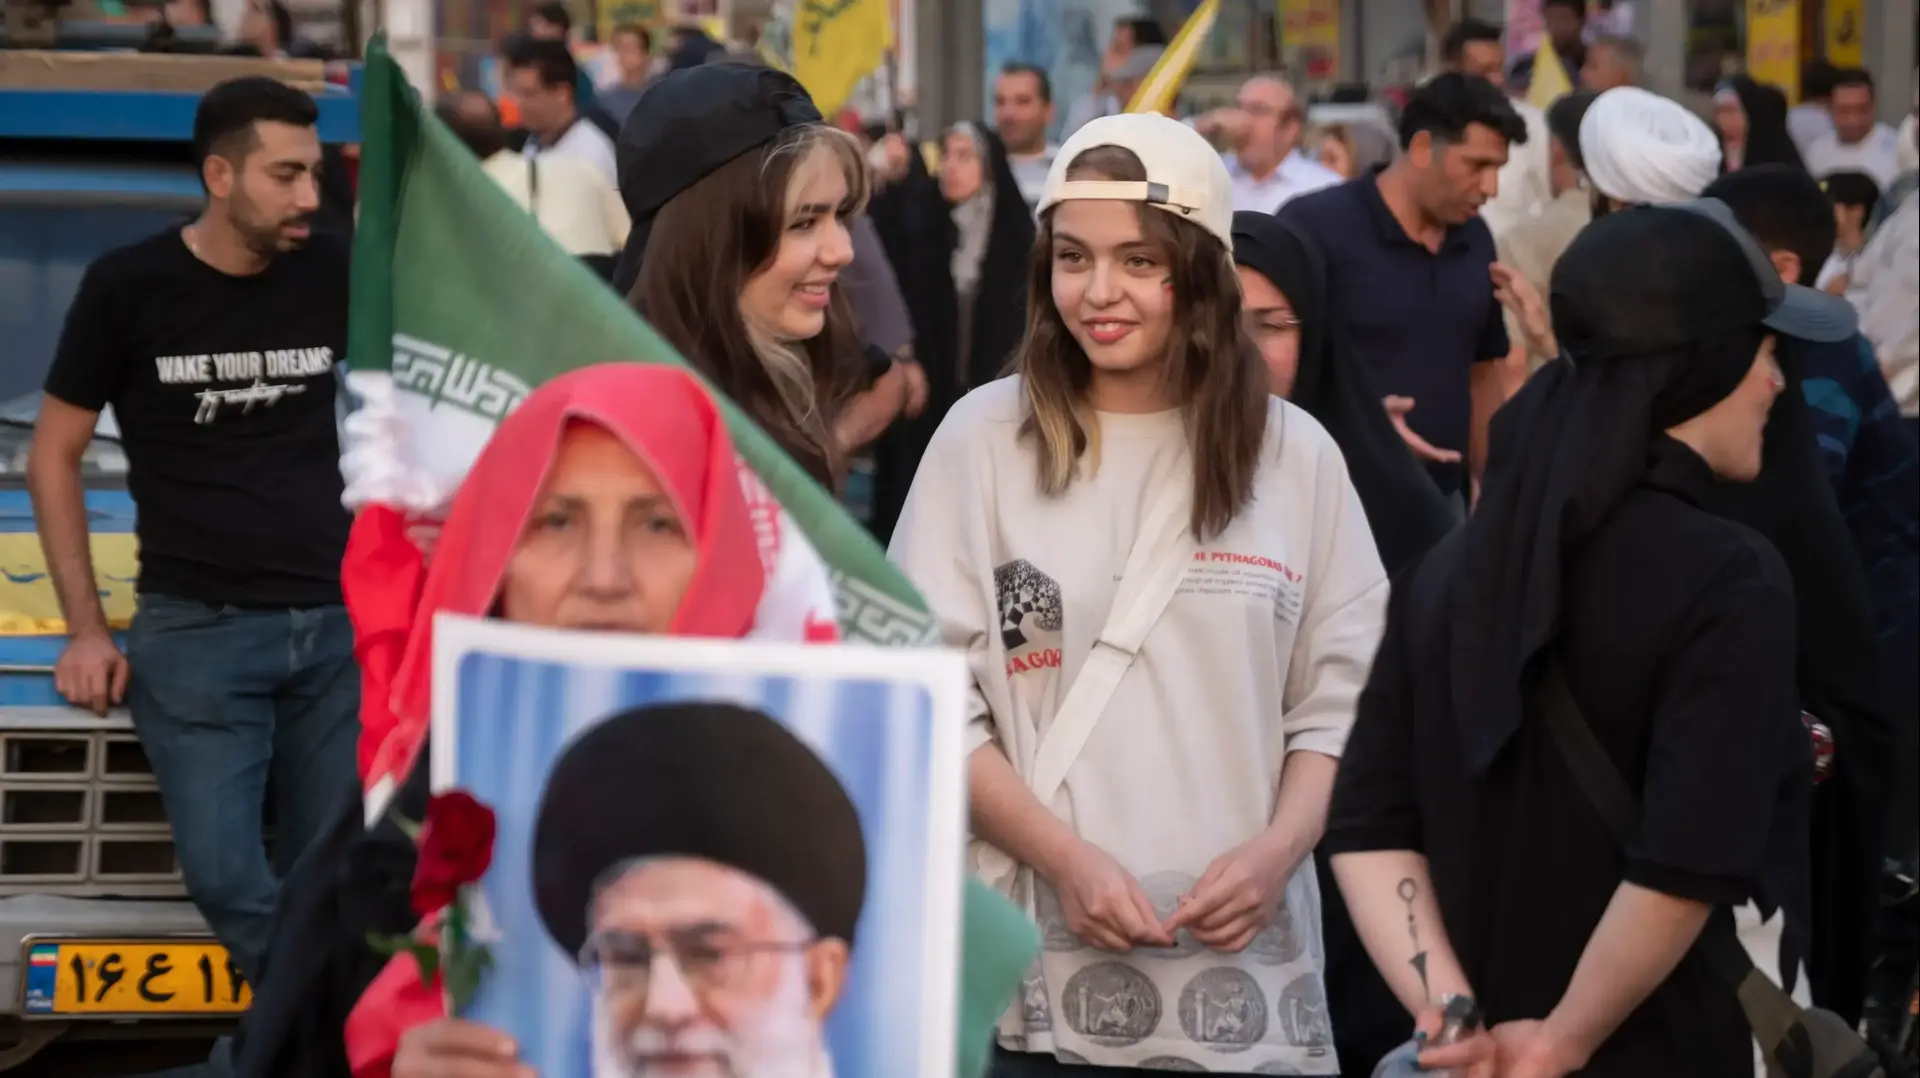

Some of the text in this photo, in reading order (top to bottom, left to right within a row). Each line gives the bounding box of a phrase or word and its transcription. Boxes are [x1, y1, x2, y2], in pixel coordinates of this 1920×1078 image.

[155, 346, 333, 383] WAKE YOUR DREAMS
